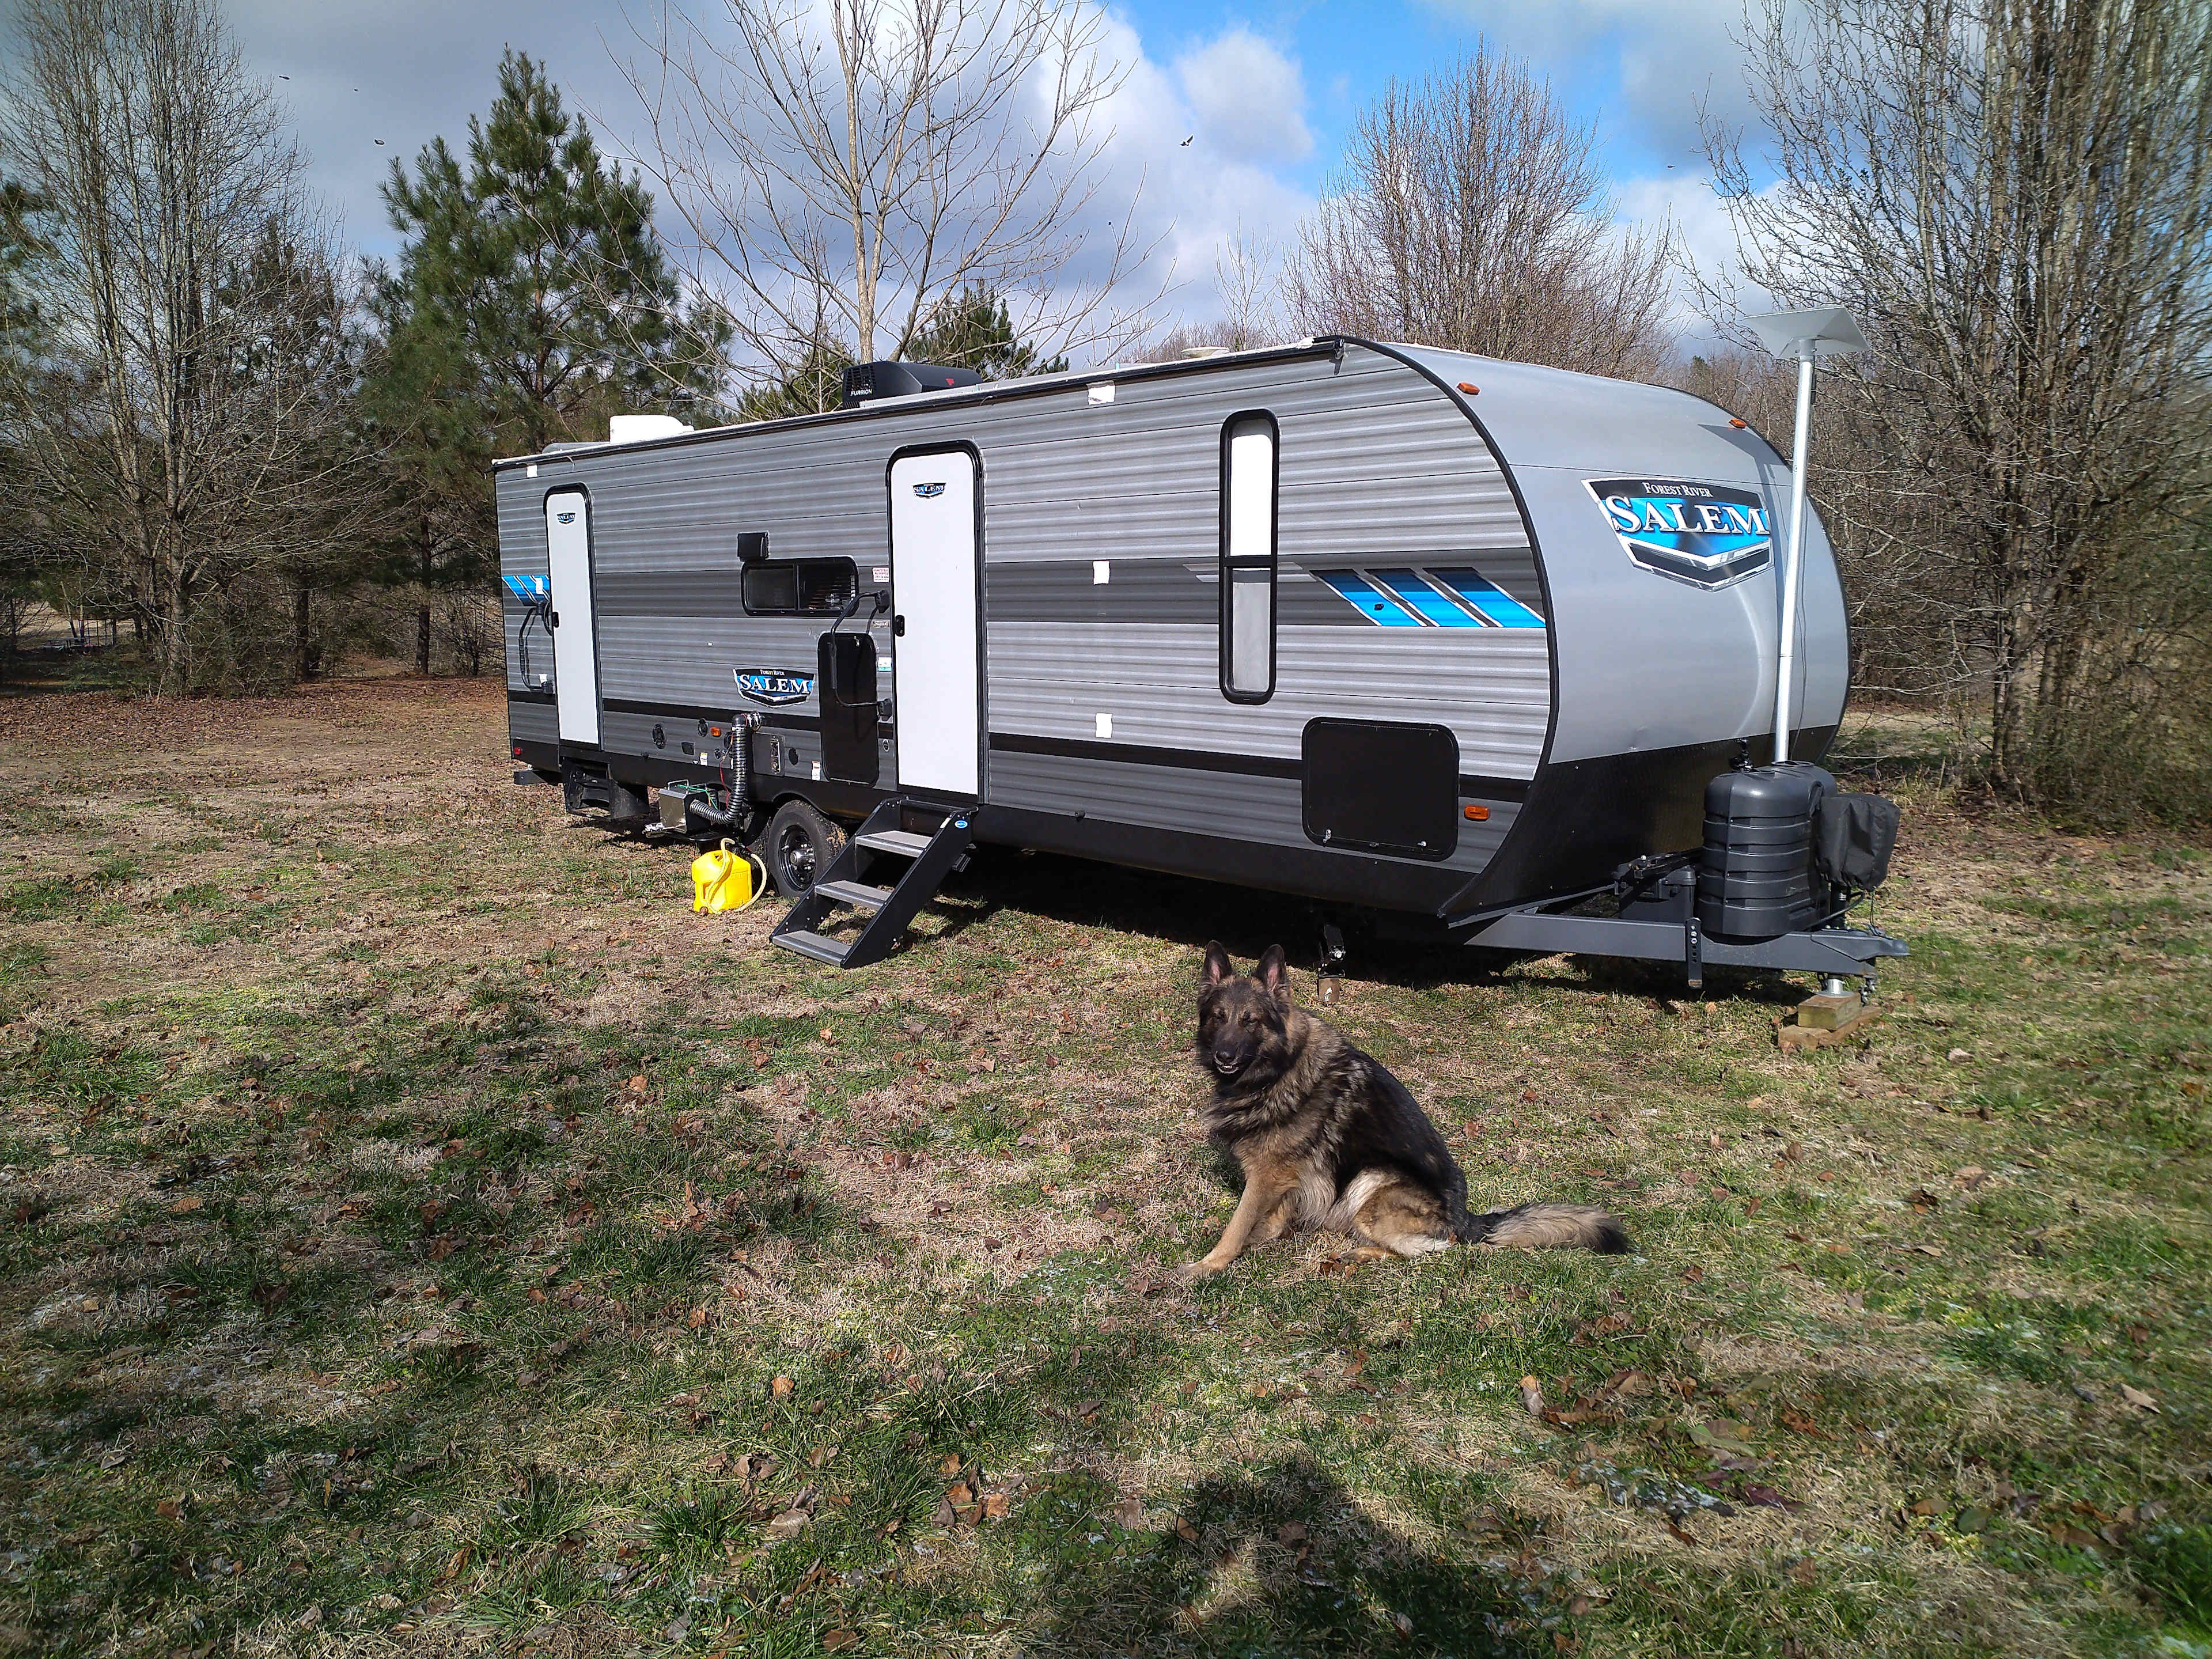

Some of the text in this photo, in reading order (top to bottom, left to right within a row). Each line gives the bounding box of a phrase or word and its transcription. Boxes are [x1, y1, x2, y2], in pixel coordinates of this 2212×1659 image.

[914, 485, 945, 493] SALEM
[1642, 482, 1714, 497] FOREST RIVER
[1605, 495, 1770, 535] SALEM
[739, 674, 810, 694] SALEM
